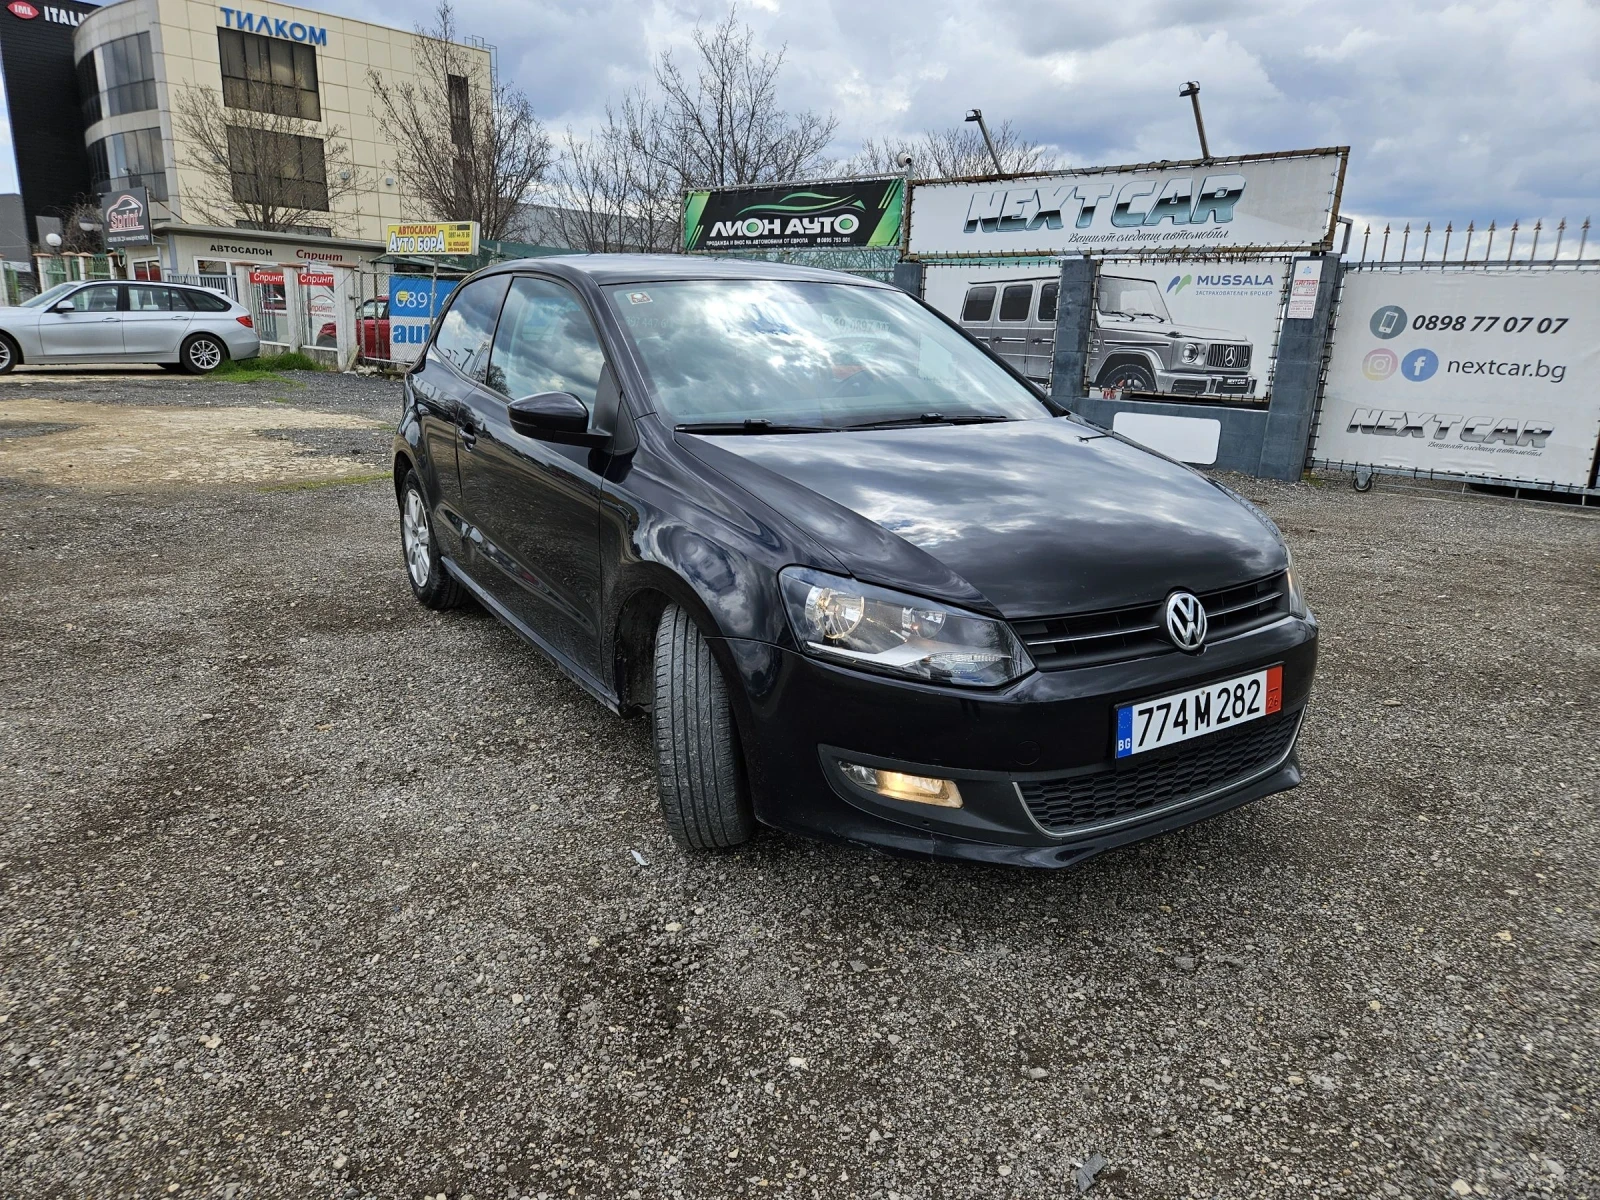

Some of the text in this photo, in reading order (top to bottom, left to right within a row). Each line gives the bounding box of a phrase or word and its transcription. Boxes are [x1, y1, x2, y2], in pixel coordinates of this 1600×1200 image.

[14, 4, 33, 16] IML
[220, 7, 327, 46] ТИЛКОМ
[963, 174, 1247, 233] NEXTCAR
[110, 209, 139, 229] Sprint
[709, 213, 860, 237] ЛИОН АУТО
[397, 225, 437, 236] АВТОСАЛОН
[1068, 226, 1229, 245] Вашият следващ автомобил
[210, 244, 343, 262] АВТОСАЛОН Спринт
[1196, 274, 1274, 286] MUSSALA
[1411, 314, 1569, 334] 0898 77 07 07
[1447, 359, 1567, 384] nextcar.bg
[1346, 408, 1555, 449] NEXTCAR
[1428, 441, 1462, 450] Вашият
[1463, 444, 1496, 454] следващ
[1267, 696, 1279, 709] 26
[1118, 738, 1131, 751] BG
